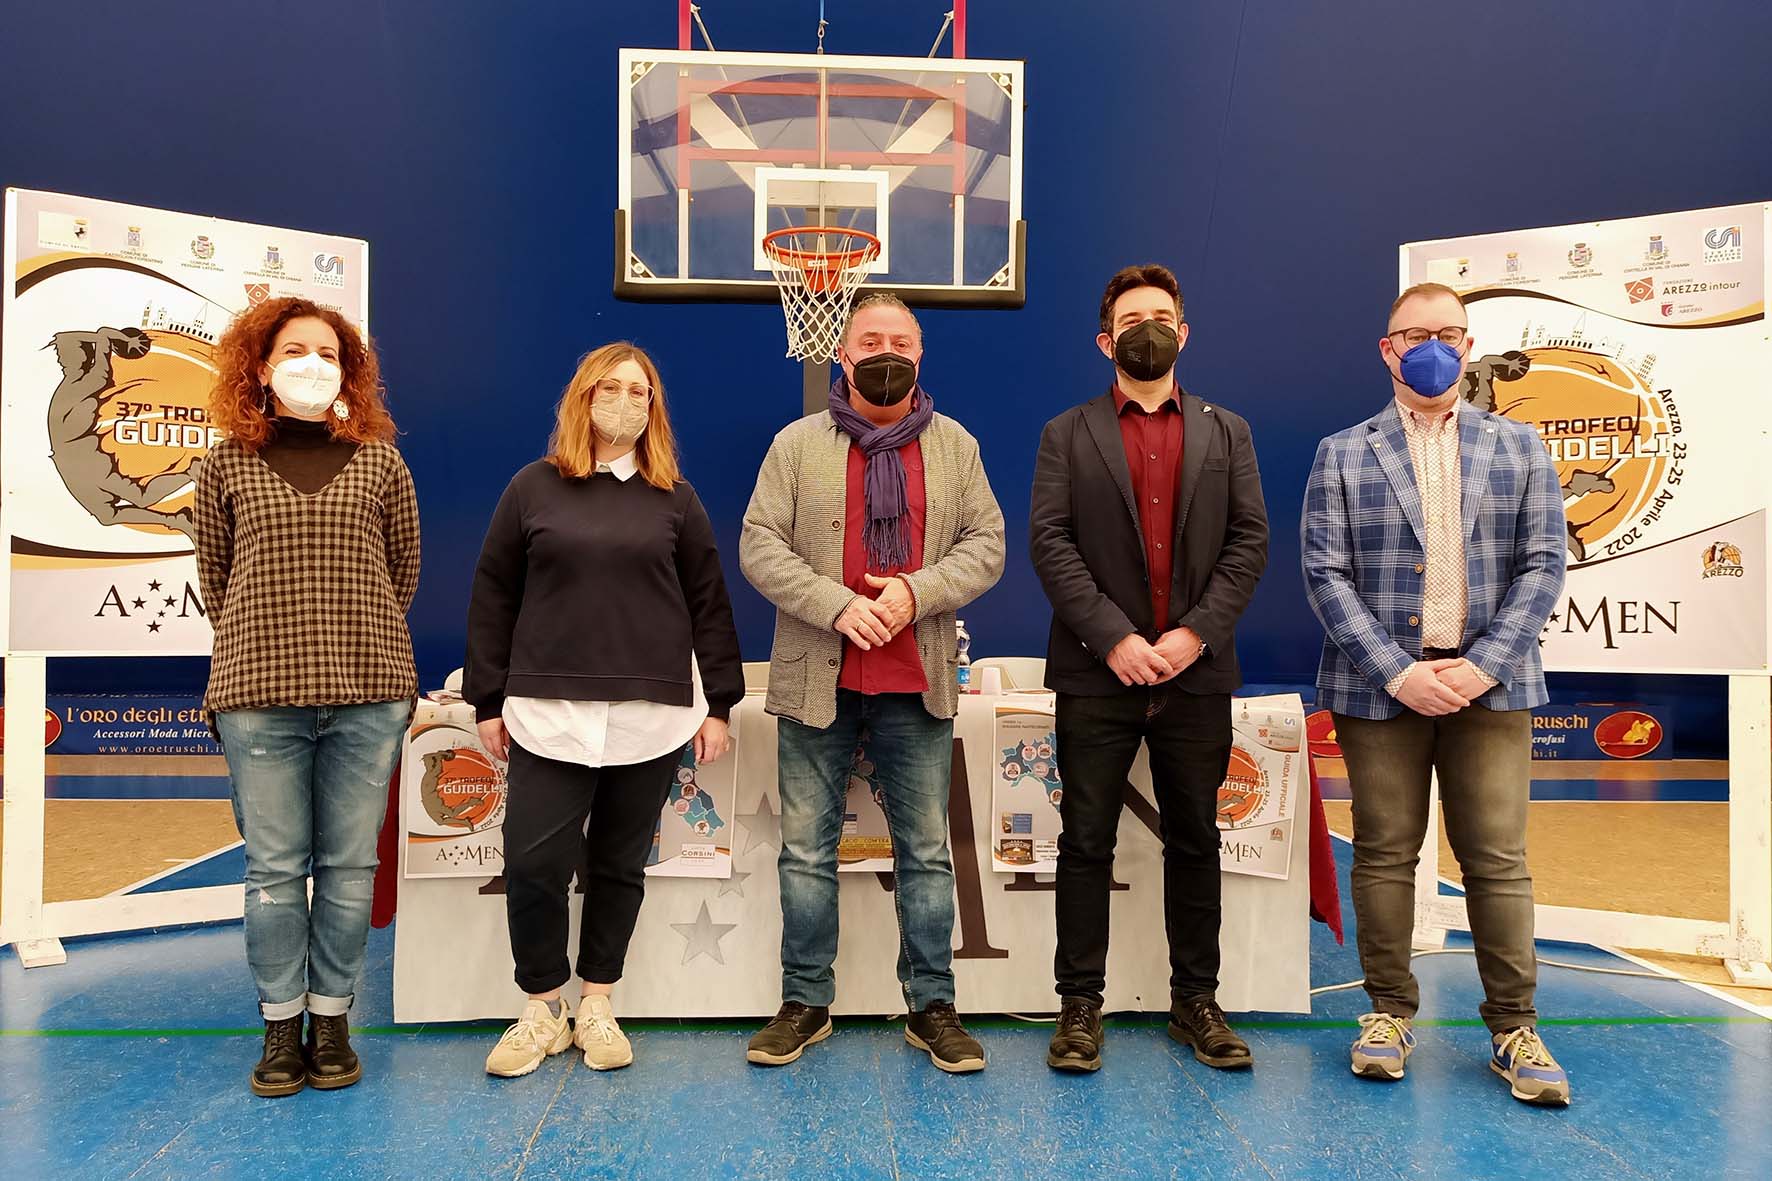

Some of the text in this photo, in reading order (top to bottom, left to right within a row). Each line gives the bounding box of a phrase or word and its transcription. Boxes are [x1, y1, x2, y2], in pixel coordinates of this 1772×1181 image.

[1662, 281, 1741, 296] AREZZO intour
[318, 304, 343, 312] ntour
[160, 404, 212, 424] TRO
[1540, 416, 1633, 436] TROFEO
[114, 420, 225, 450] GUIDE
[1543, 433, 1671, 462] IDELLI
[1604, 388, 1688, 556] Arezzo, 23-25 Aprile 2022
[1702, 565, 1745, 580] AREZZO
[1532, 714, 1589, 729] RUSCHI
[93, 728, 214, 739] Accessori Moda Micro
[1532, 734, 1566, 746] crofusi
[1282, 754, 1292, 778] GUIDA
[1227, 774, 1254, 783] ROFEO
[1222, 781, 1264, 794] IDELLI
[681, 850, 716, 858] CORSINI
